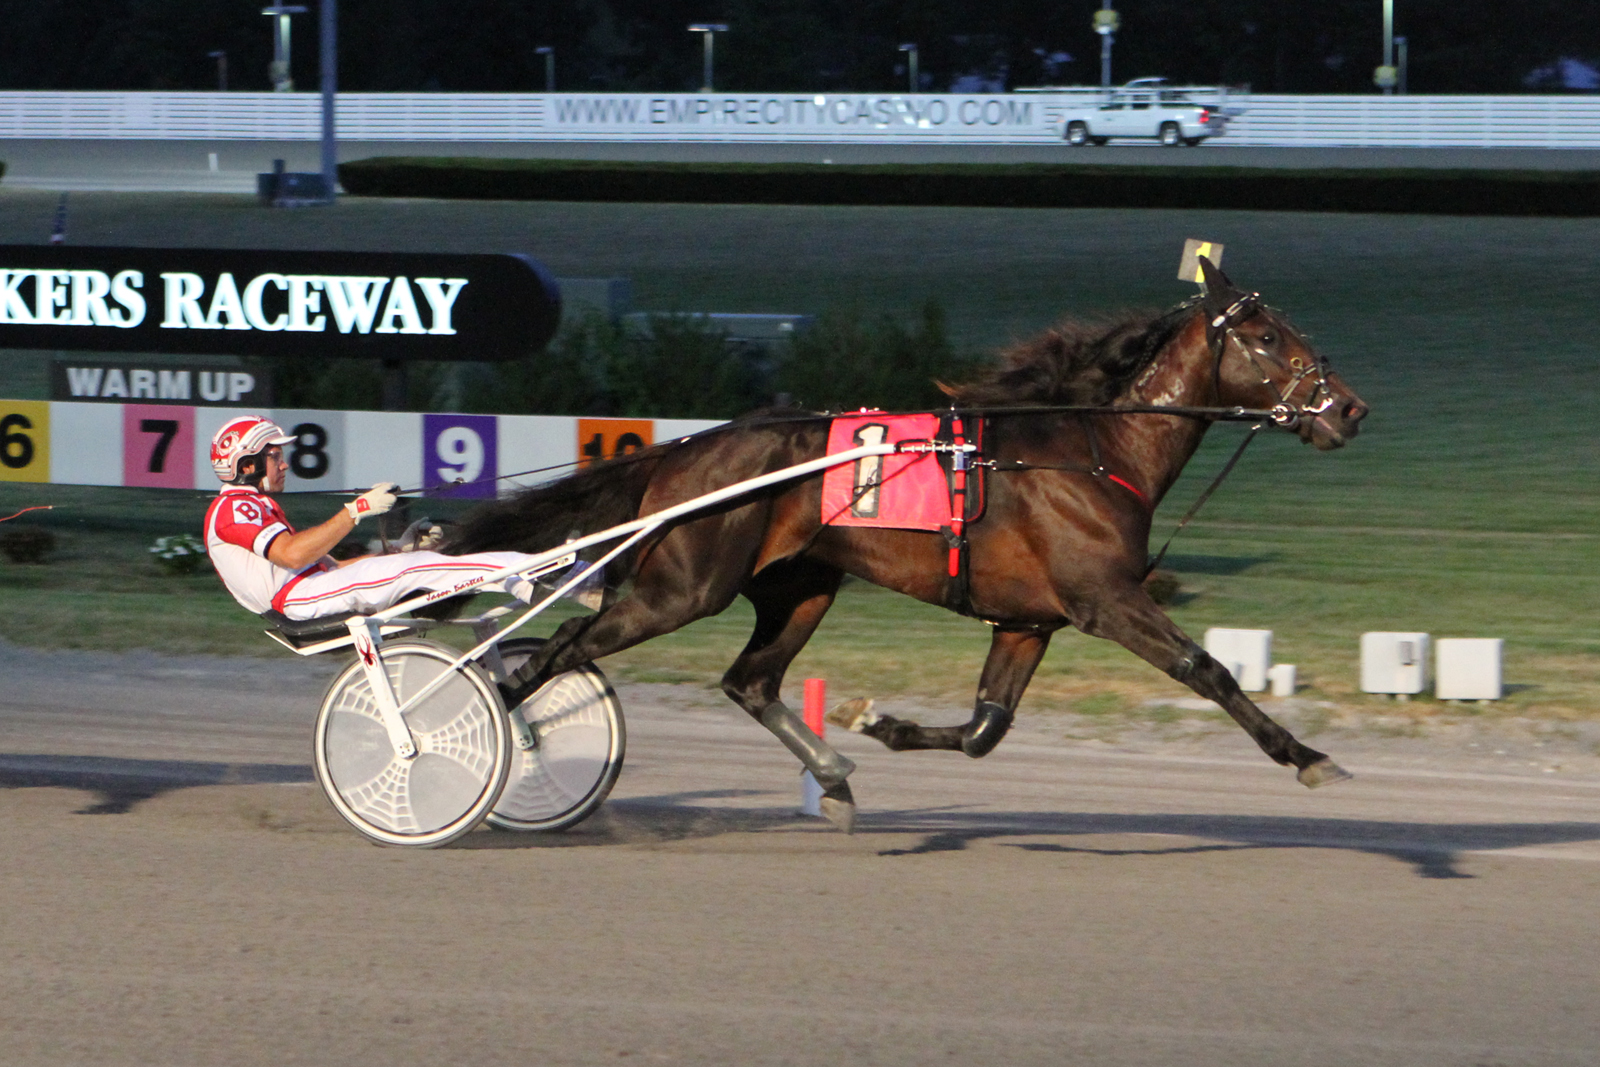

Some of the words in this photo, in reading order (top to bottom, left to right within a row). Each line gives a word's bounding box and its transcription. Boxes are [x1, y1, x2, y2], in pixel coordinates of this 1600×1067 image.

[0, 268, 147, 329] KERS
[160, 272, 469, 336] RACEWAY
[66, 367, 192, 399] WARM
[200, 371, 256, 402] UP
[0, 413, 34, 469] 6
[140, 418, 179, 473] 7
[290, 422, 329, 480] 8
[436, 425, 486, 484] 9
[853, 422, 889, 519] 1
[235, 502, 260, 522] B
